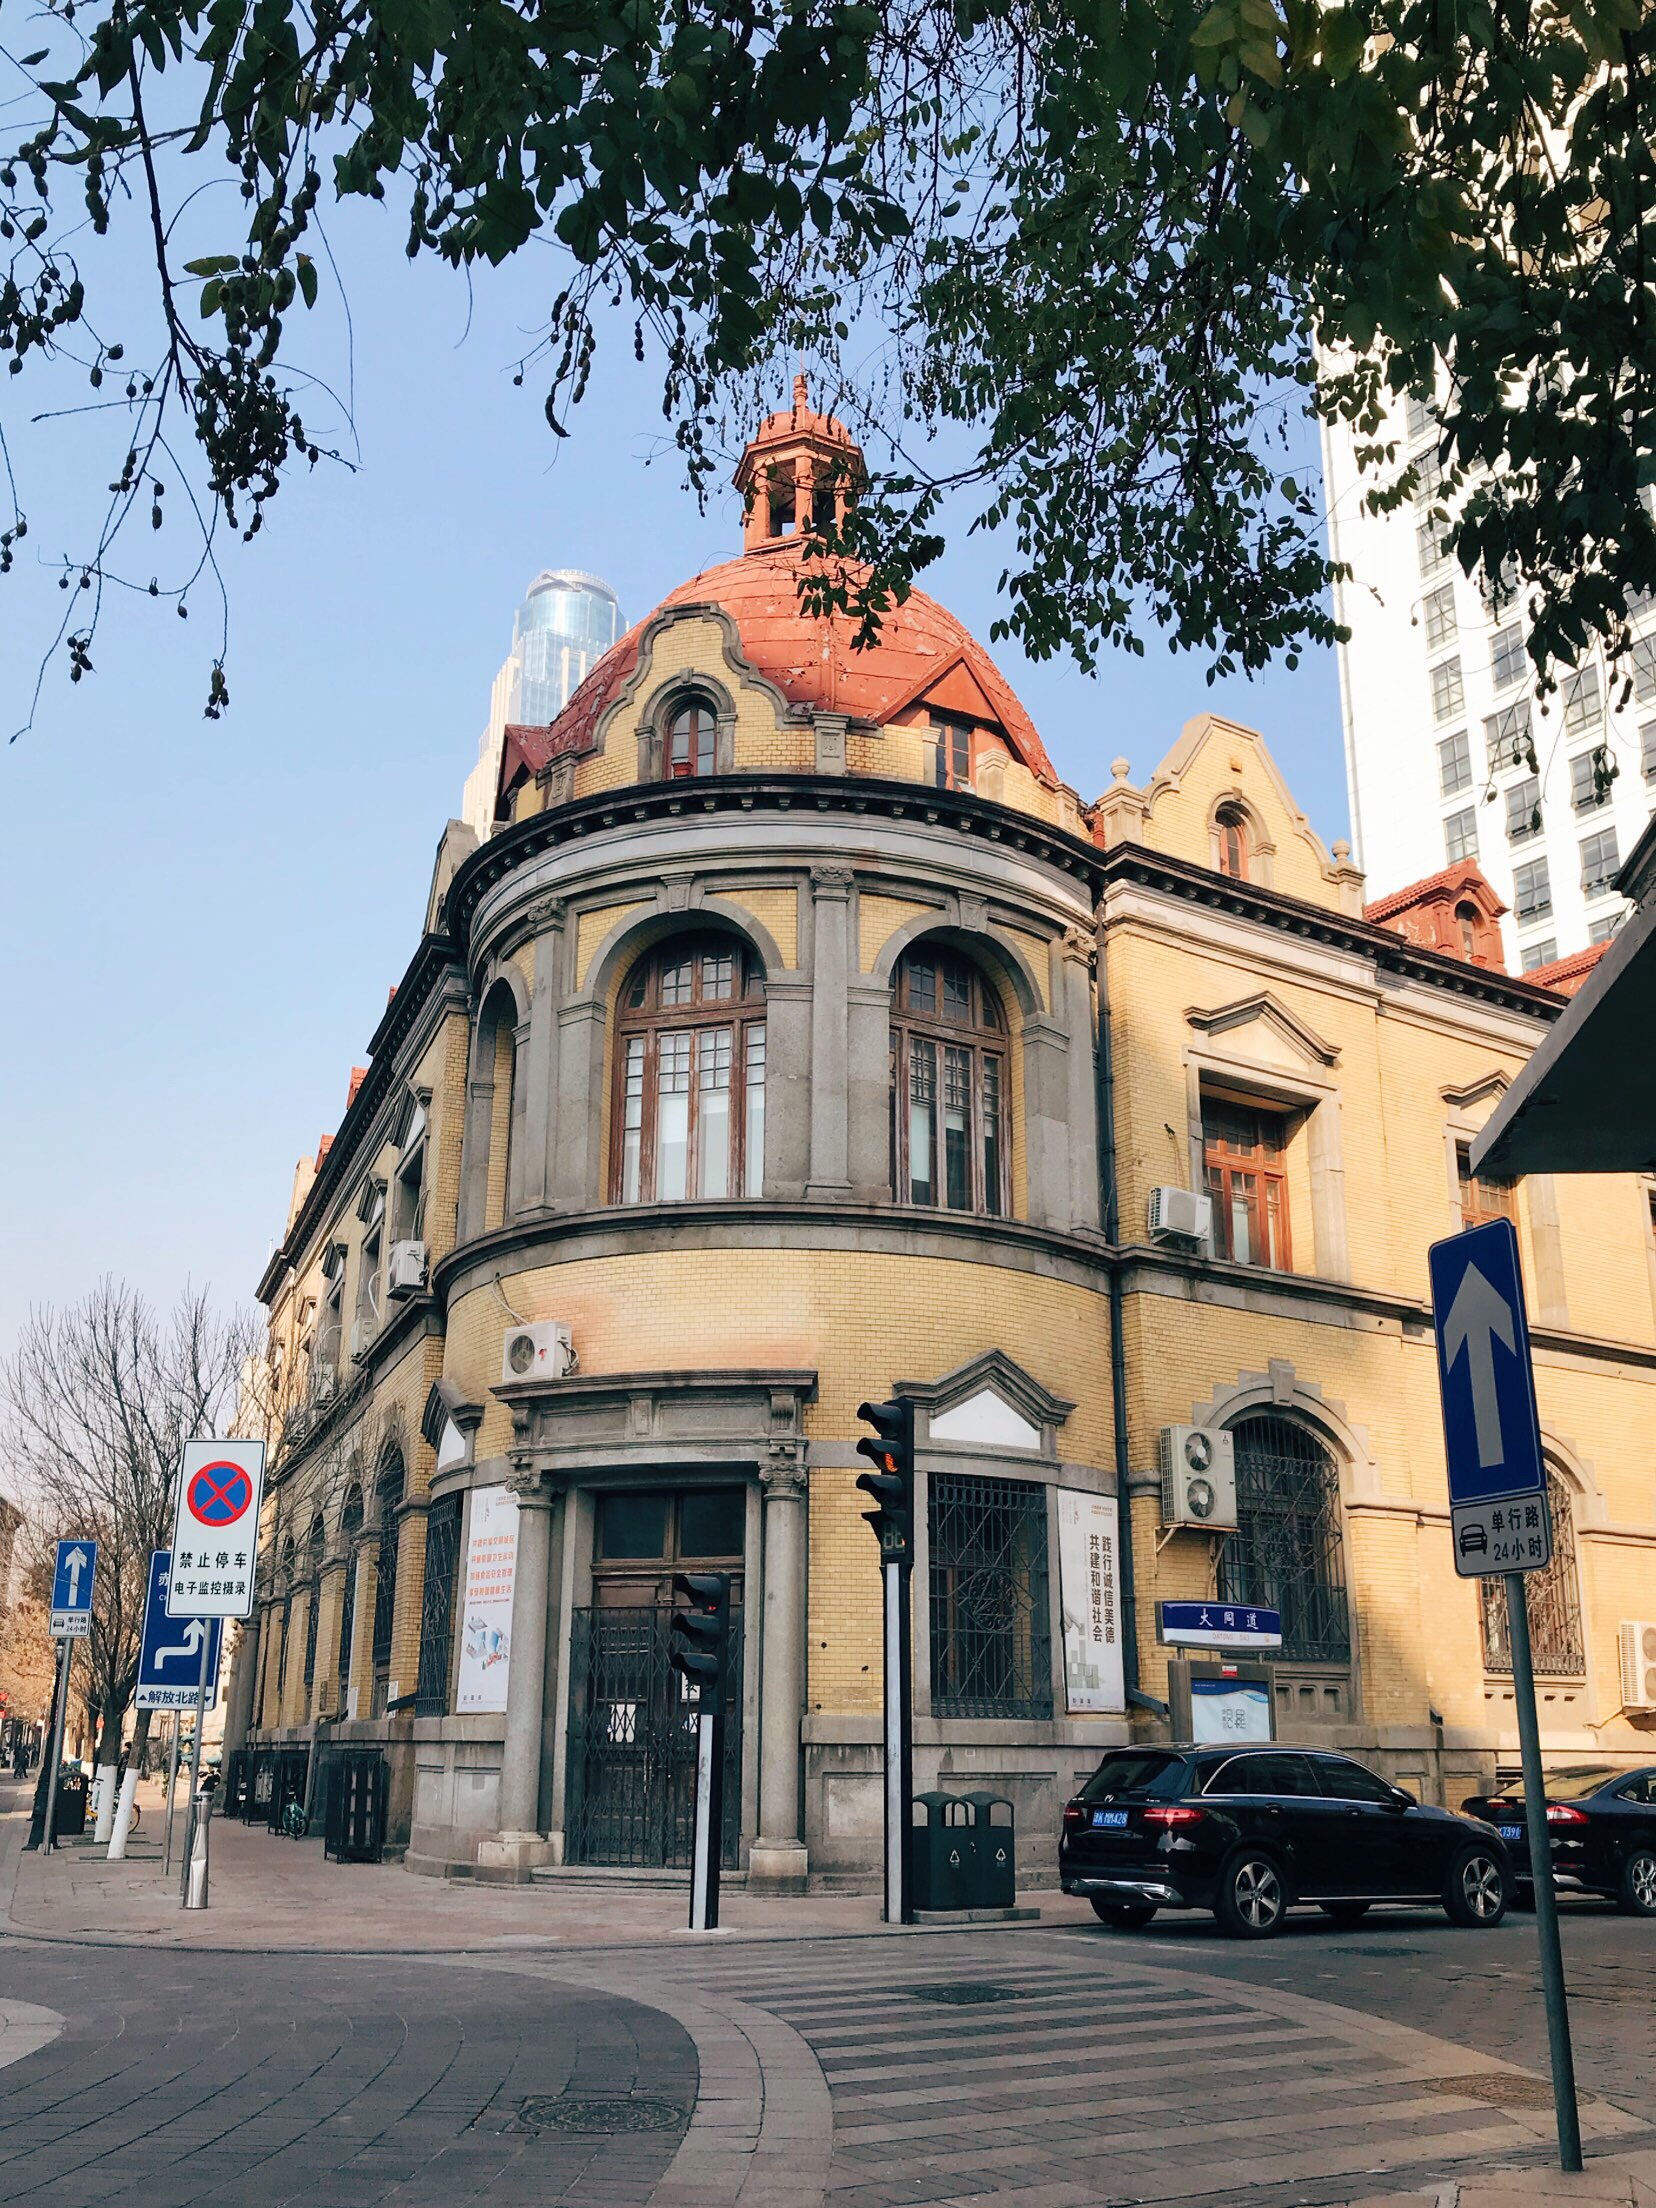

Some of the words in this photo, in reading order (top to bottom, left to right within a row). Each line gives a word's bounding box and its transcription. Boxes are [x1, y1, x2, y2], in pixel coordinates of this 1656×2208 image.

[1491, 1504, 1539, 1533] 单行路
[1493, 1535, 1542, 1561] 24小时
[179, 1551, 247, 1569] 禁止停车
[174, 1580, 246, 1595] 电子监控摄录
[1089, 1533, 1102, 1643] 共建和谐社会
[1102, 1535, 1115, 1644] 践行诚信美德
[67, 1616, 87, 1624] 单行路
[1198, 1607, 1259, 1630] 大同道
[66, 1625, 87, 1633] 24小时
[147, 1689, 200, 1705] 解放北路
